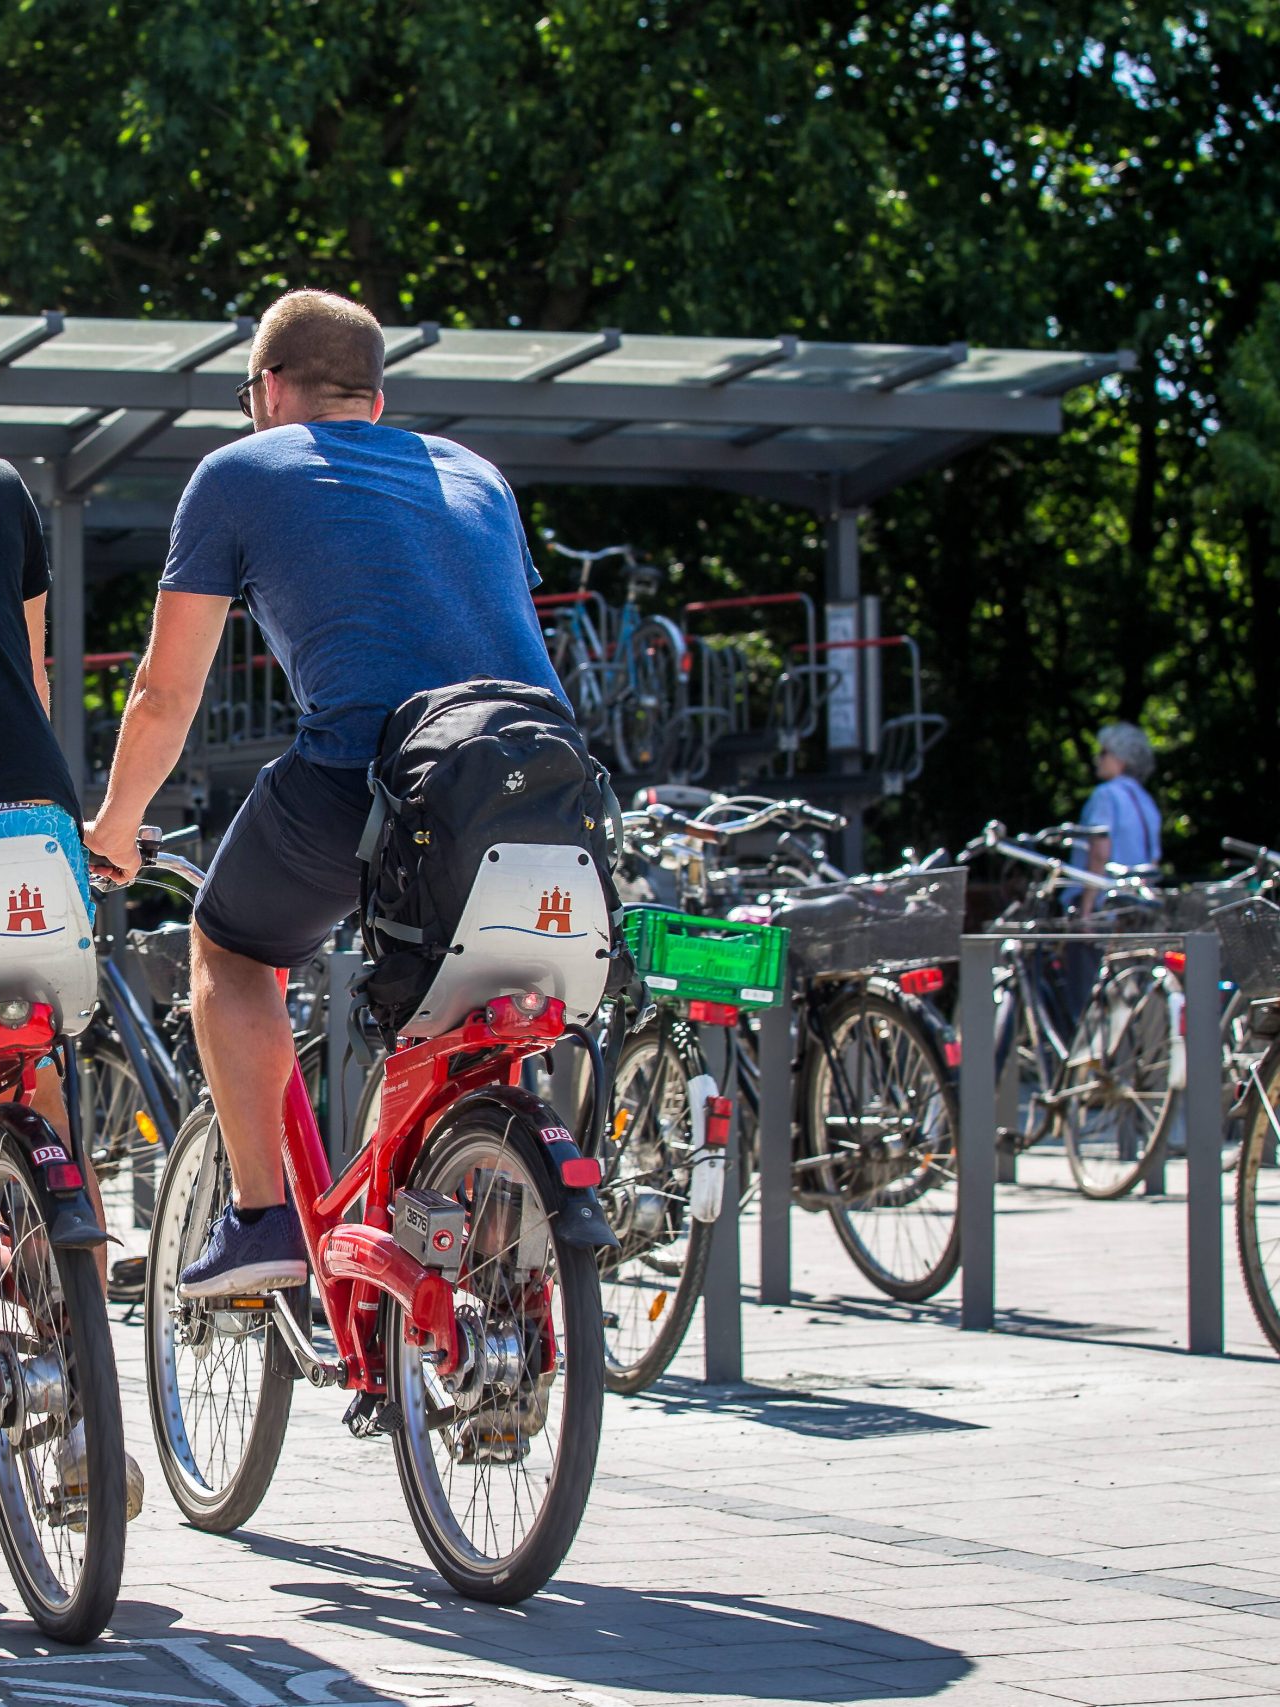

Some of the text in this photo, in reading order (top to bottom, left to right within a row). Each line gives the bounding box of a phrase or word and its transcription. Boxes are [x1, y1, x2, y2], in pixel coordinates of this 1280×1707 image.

[544, 1128, 570, 1140] DB
[35, 1147, 64, 1161] DB
[406, 1208, 428, 1232] 3876
